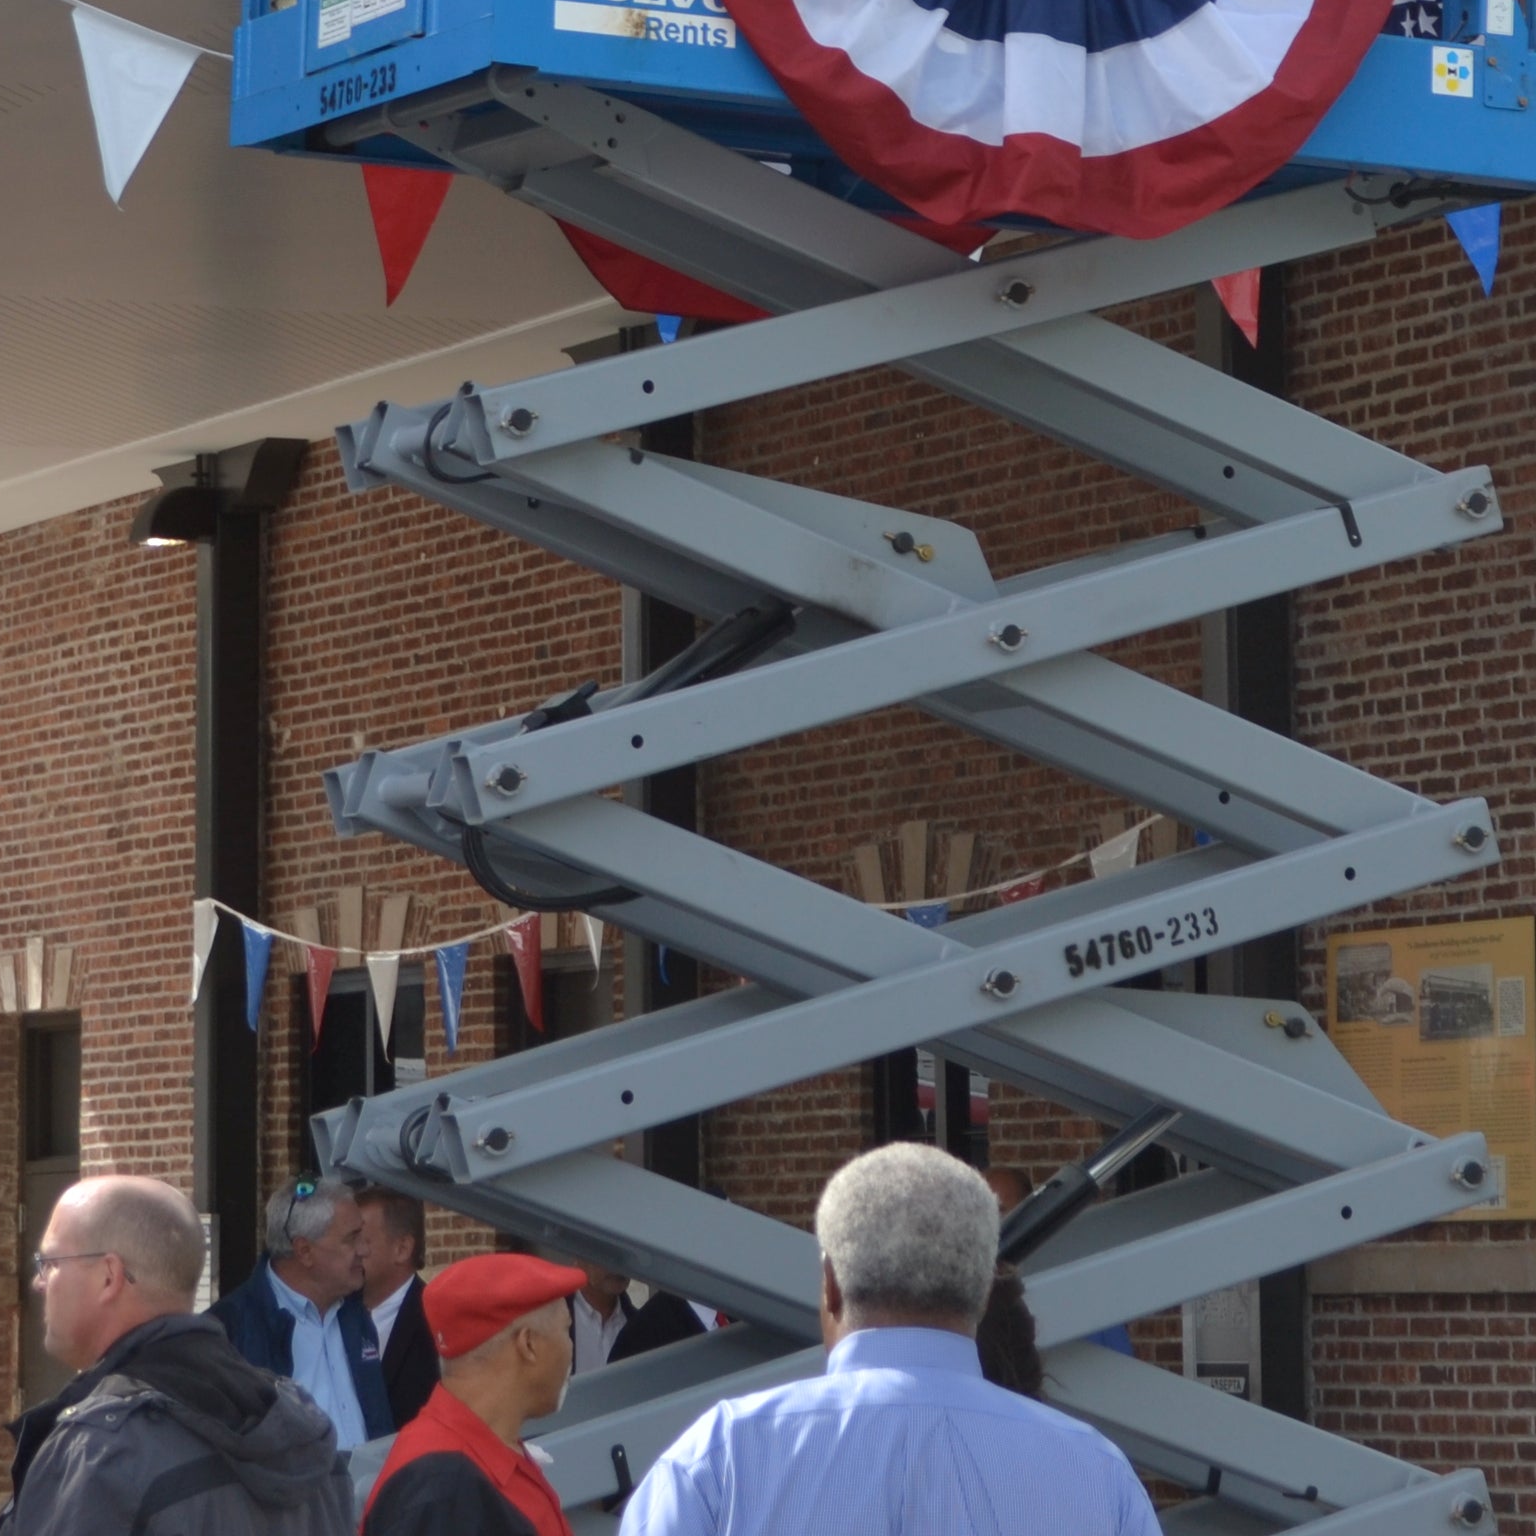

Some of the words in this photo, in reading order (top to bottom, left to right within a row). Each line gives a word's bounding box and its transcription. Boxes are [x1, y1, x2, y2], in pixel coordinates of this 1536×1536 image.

[645, 15, 728, 46] Rents
[320, 61, 396, 116] 54760-233
[1064, 906, 1219, 978] 54760-233
